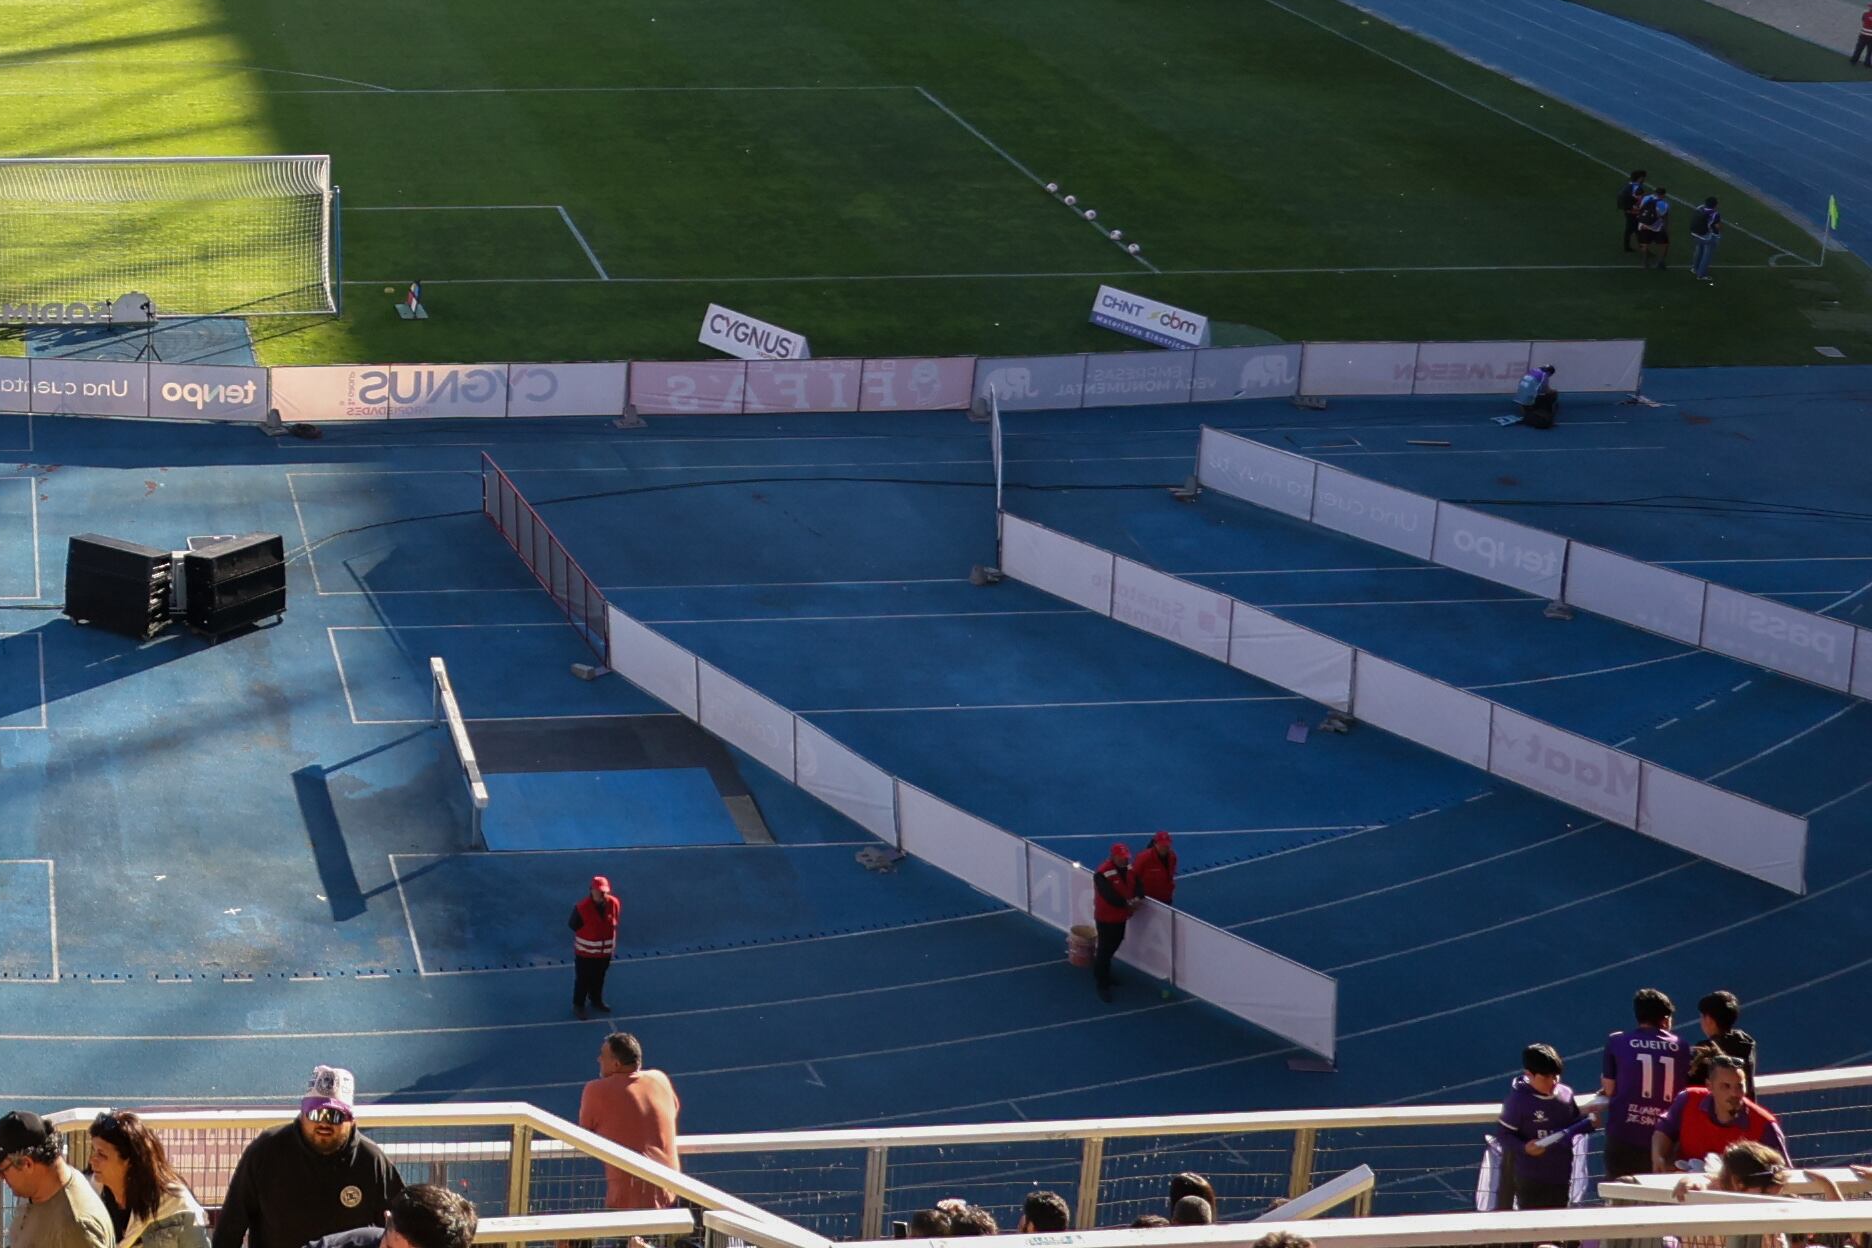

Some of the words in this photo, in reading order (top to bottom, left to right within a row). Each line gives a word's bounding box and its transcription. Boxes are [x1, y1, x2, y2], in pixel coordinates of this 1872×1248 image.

[710, 314, 793, 358] CYGNUS
[1160, 310, 1198, 336] cbm
[1630, 1038, 1680, 1052] GUEITO
[1636, 1053, 1675, 1103] 11
